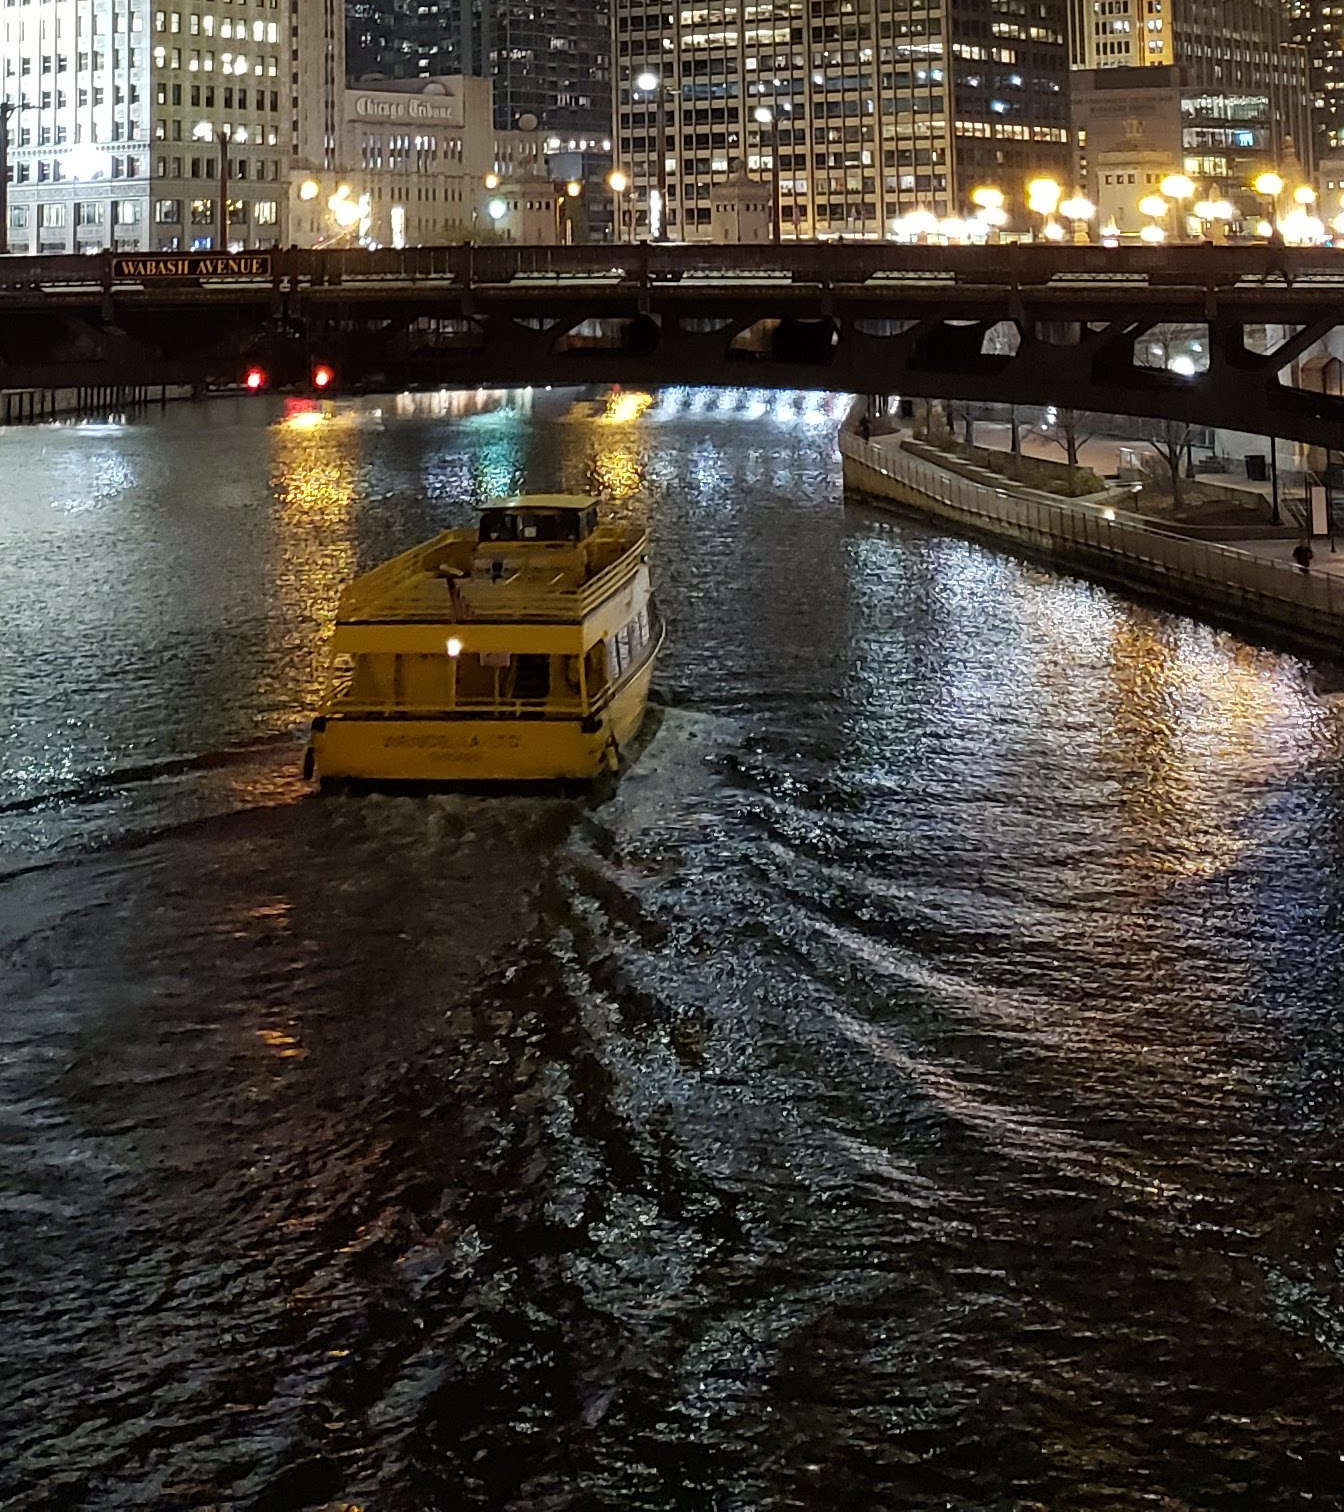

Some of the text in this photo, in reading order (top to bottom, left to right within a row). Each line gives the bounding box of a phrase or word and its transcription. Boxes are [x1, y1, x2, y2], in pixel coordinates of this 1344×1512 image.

[357, 97, 452, 119] Chicago Tribune
[122, 258, 263, 275] WABASH AVENUE
